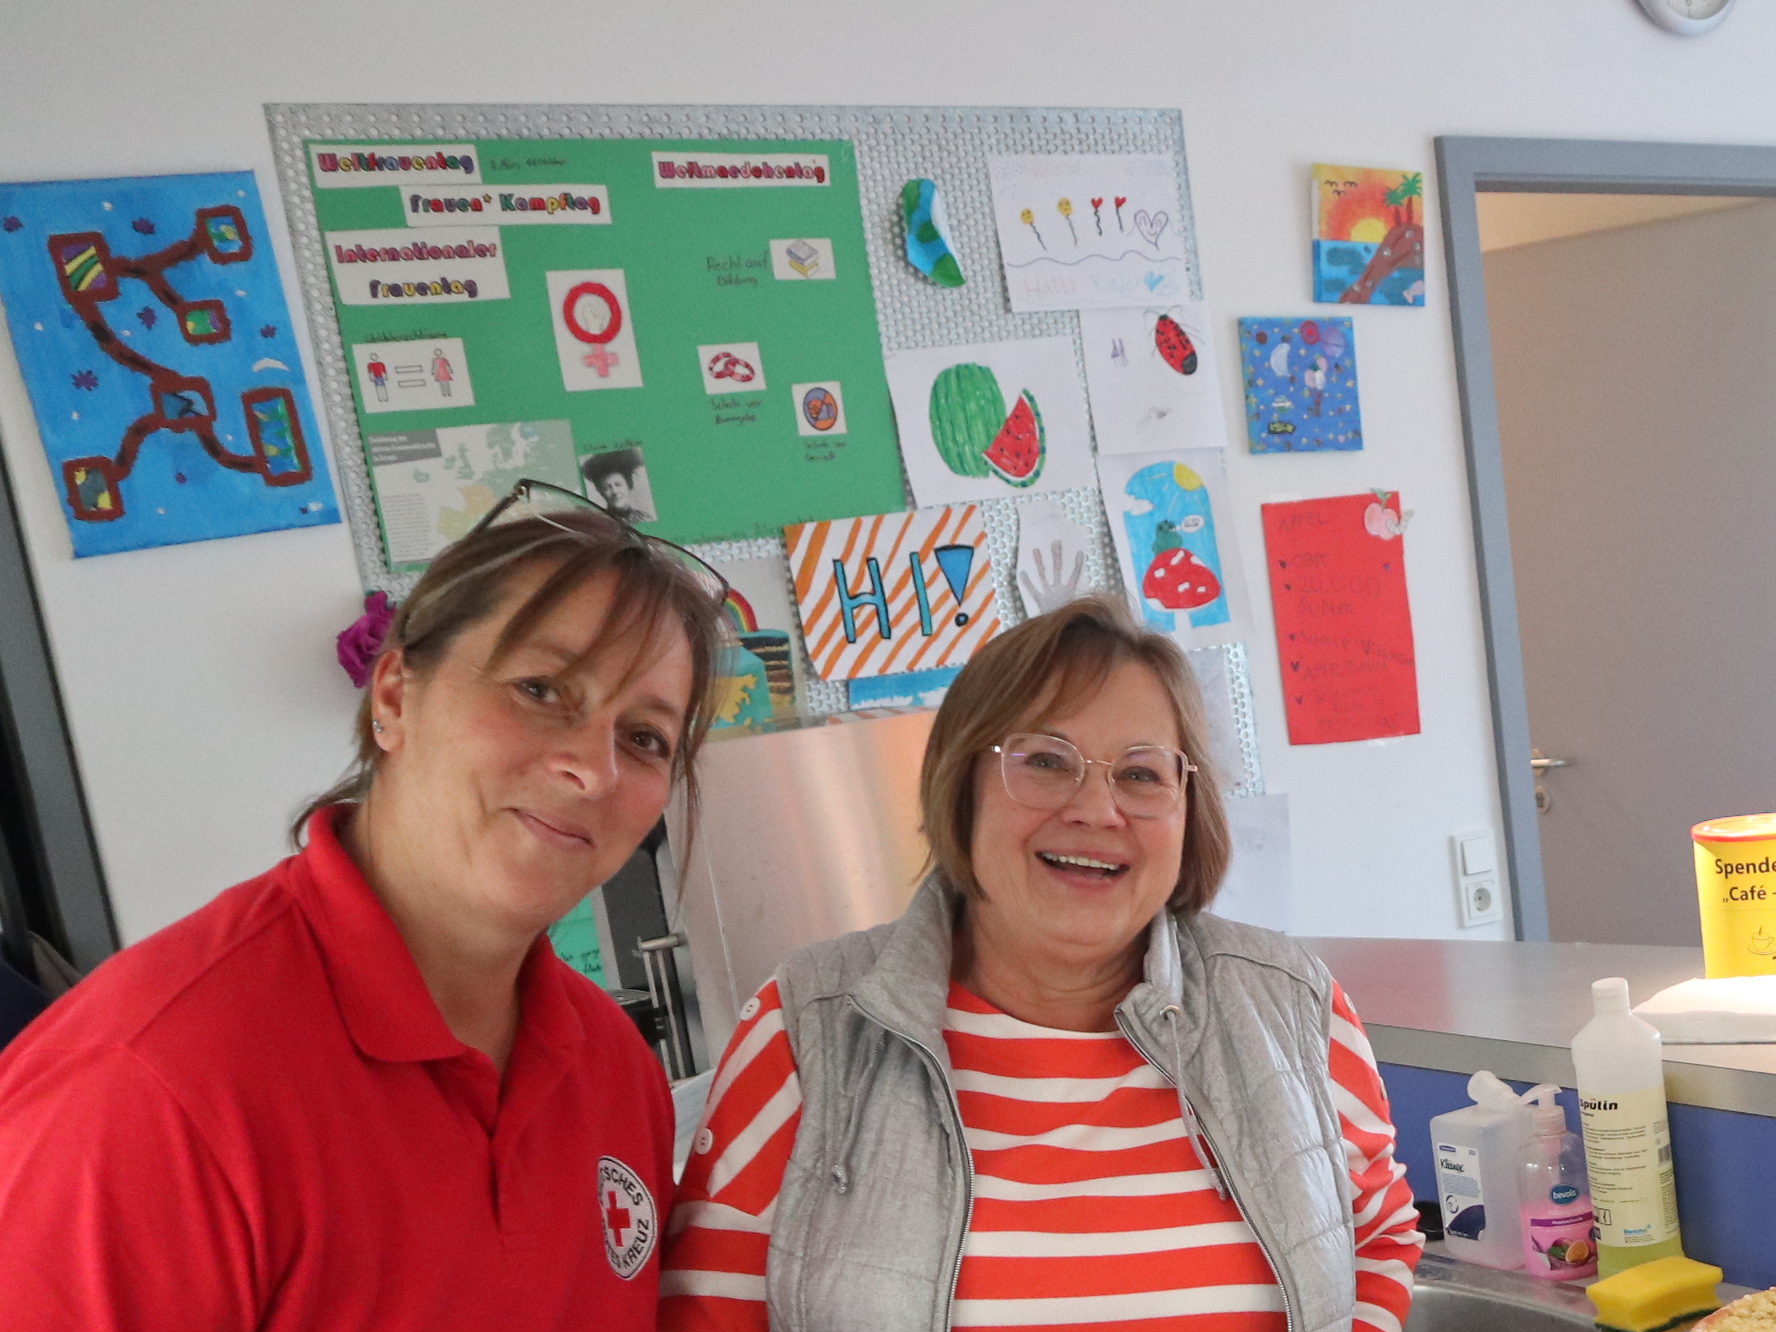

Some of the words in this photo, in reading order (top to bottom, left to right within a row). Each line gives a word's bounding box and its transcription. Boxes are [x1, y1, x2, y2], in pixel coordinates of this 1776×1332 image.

[316, 152, 475, 175] Weltfrauentag
[658, 161, 826, 184] Weltmaedchentag
[498, 192, 601, 215] Kampftag
[334, 240, 497, 264] Internationaler
[369, 277, 479, 299] Frauentag
[832, 544, 975, 644] HI!
